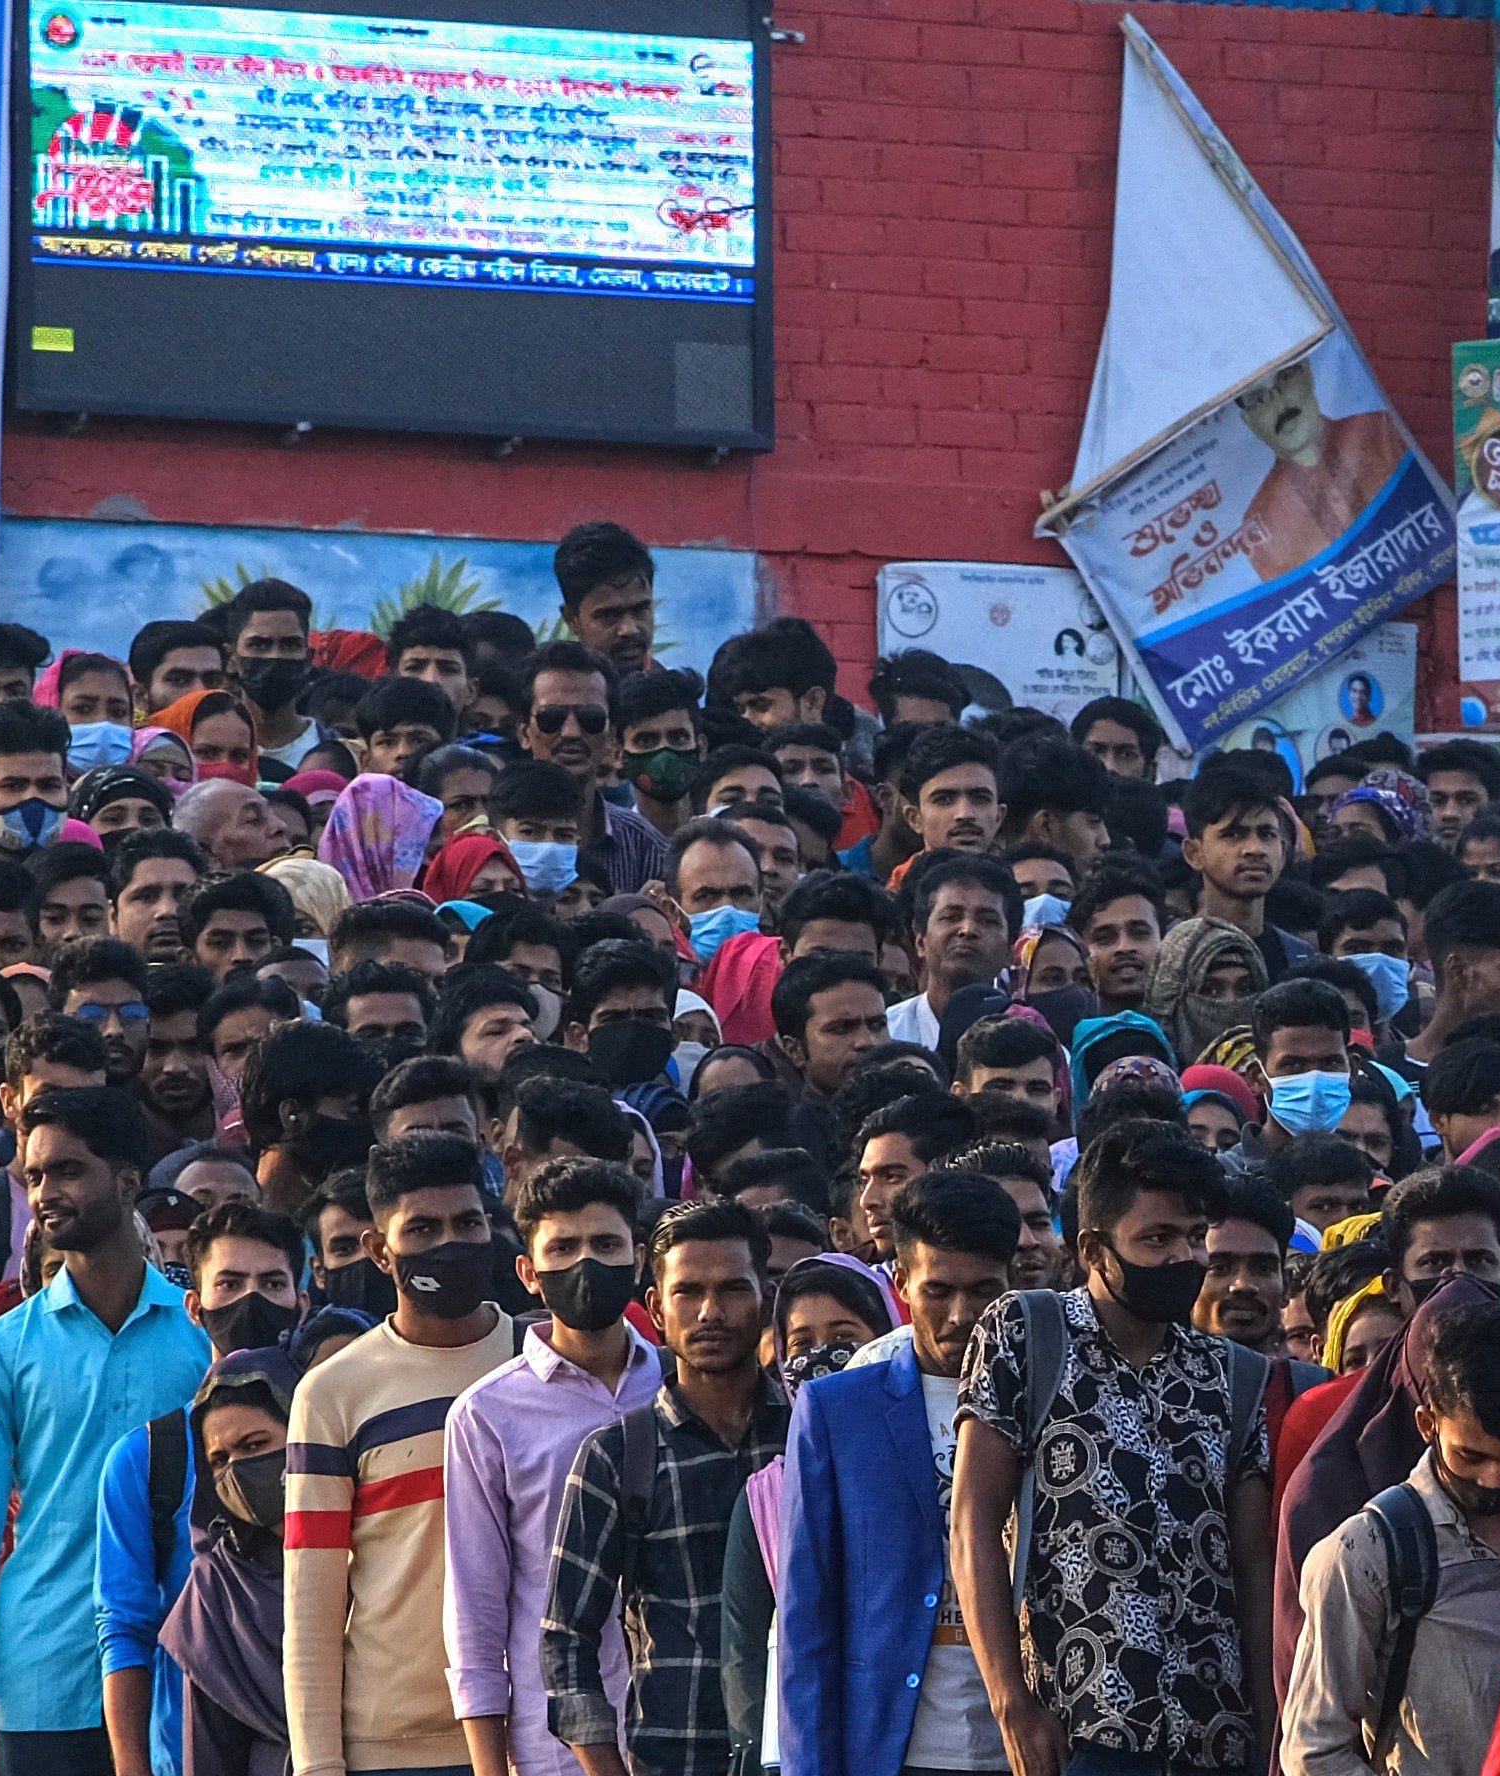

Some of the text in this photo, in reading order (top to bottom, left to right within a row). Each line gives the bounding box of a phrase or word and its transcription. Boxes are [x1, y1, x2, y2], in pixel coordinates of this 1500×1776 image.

[1144, 512, 1272, 615] অভিনন্দন
[1192, 520, 1219, 548] ও
[1166, 501, 1447, 710] মোঃ ইকরাম ইজারাদার
